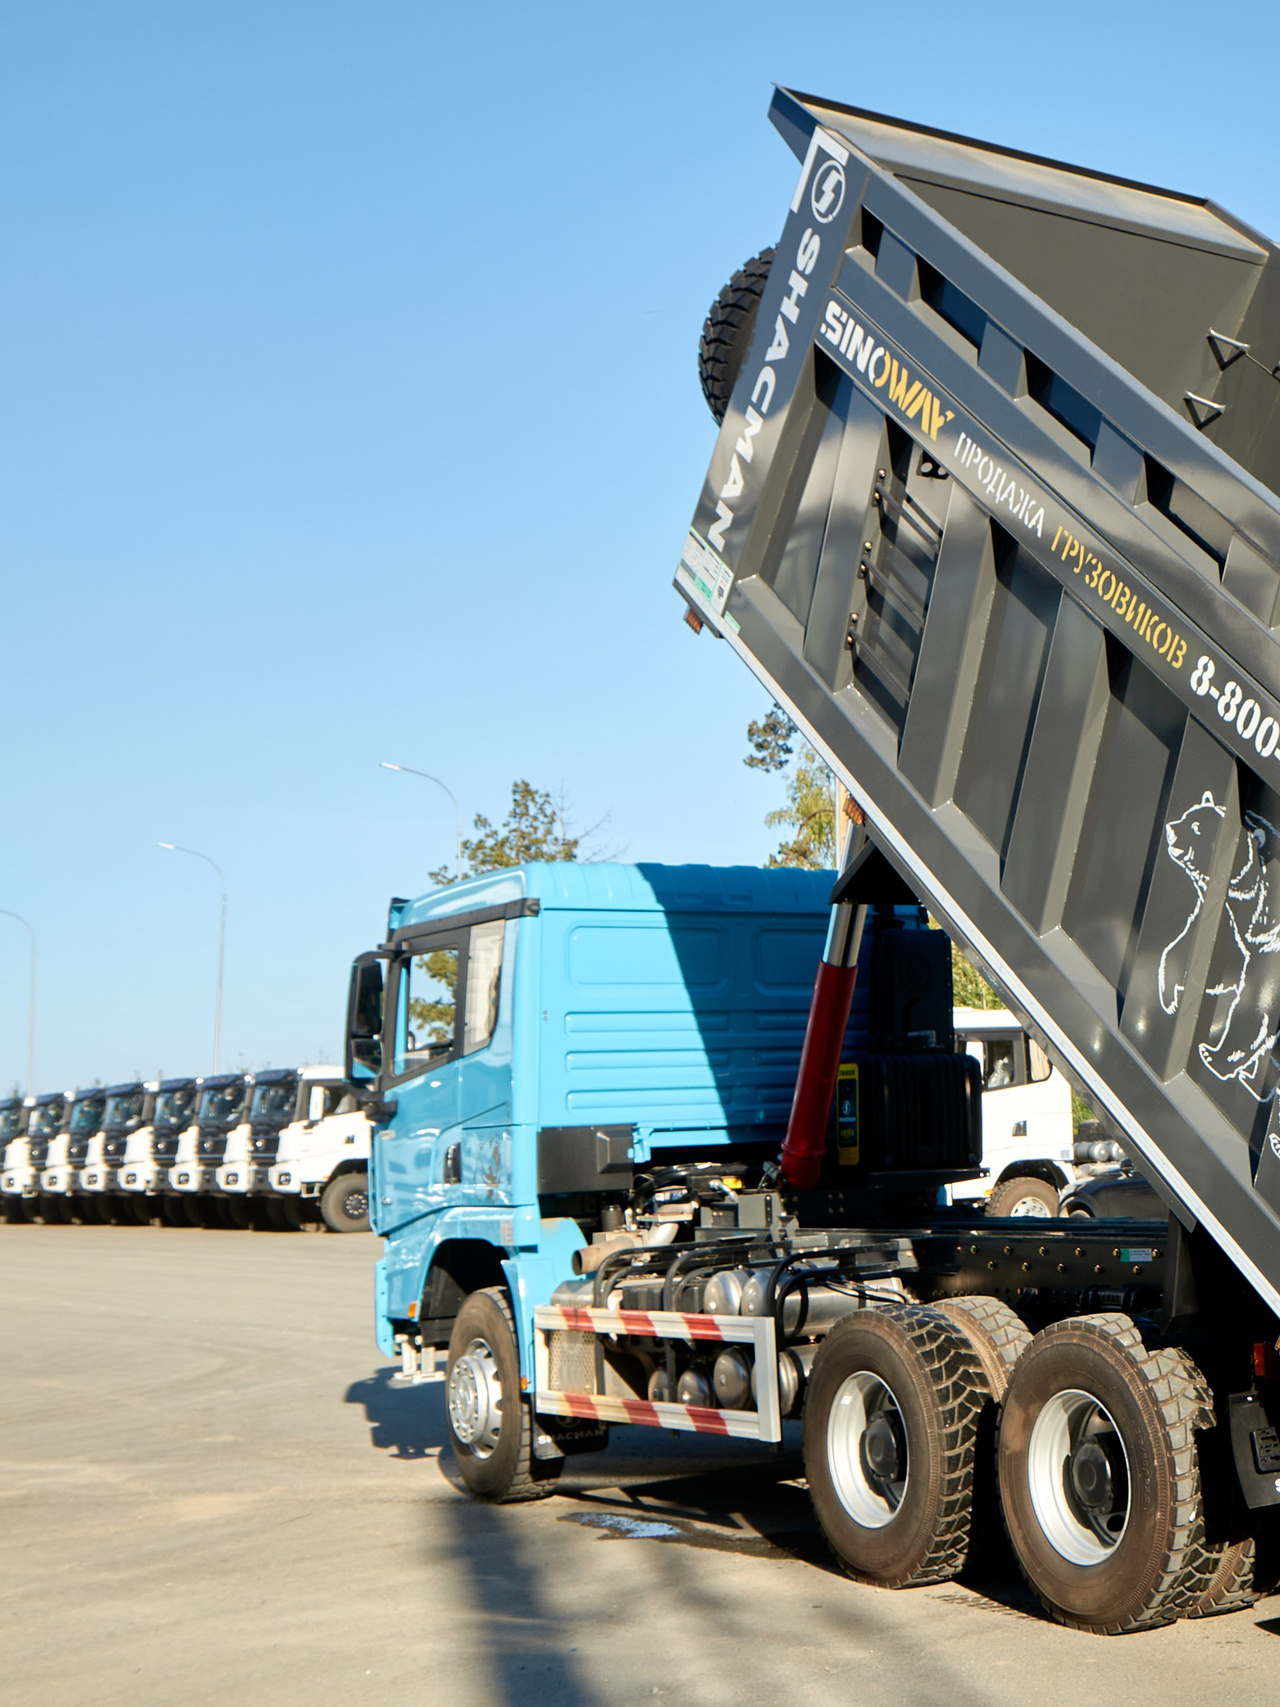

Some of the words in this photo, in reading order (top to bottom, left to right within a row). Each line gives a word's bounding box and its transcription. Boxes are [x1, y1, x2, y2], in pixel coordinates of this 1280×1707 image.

[707, 227, 821, 553] SHACMAN
[820, 300, 955, 442] SINOWAY
[953, 431, 1045, 538] ПРОДАЖА
[1051, 525, 1188, 669] ГРУЗОВИКОВ
